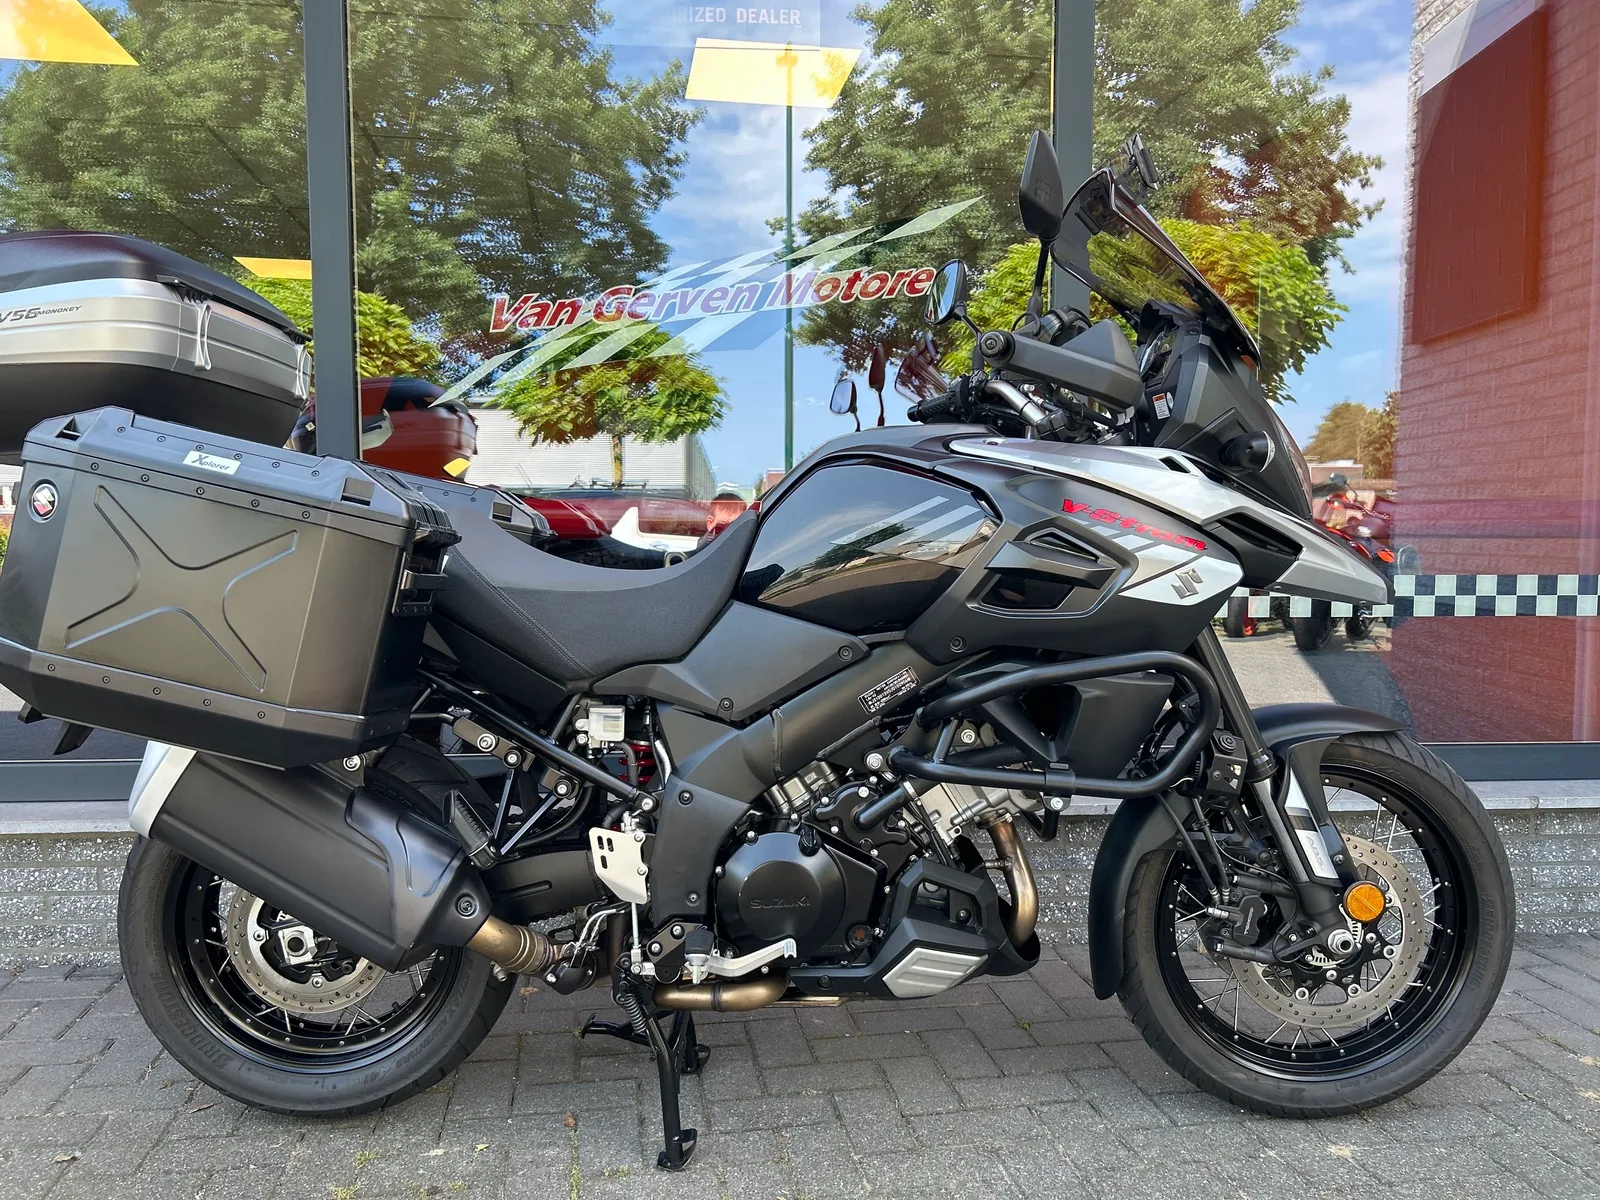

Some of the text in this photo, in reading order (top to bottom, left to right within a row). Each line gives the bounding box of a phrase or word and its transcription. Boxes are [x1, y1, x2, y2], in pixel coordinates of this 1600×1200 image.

[671, 6, 801, 25] RIZED DEALER
[490, 266, 937, 333] Van Gerven Motore
[36, 305, 82, 316] MONOKEY
[191, 454, 231, 471] Xplorer
[1062, 498, 1208, 551] V-Strom
[750, 896, 812, 909] SUZUKI
[149, 971, 235, 1071] BRIDGESTONE
